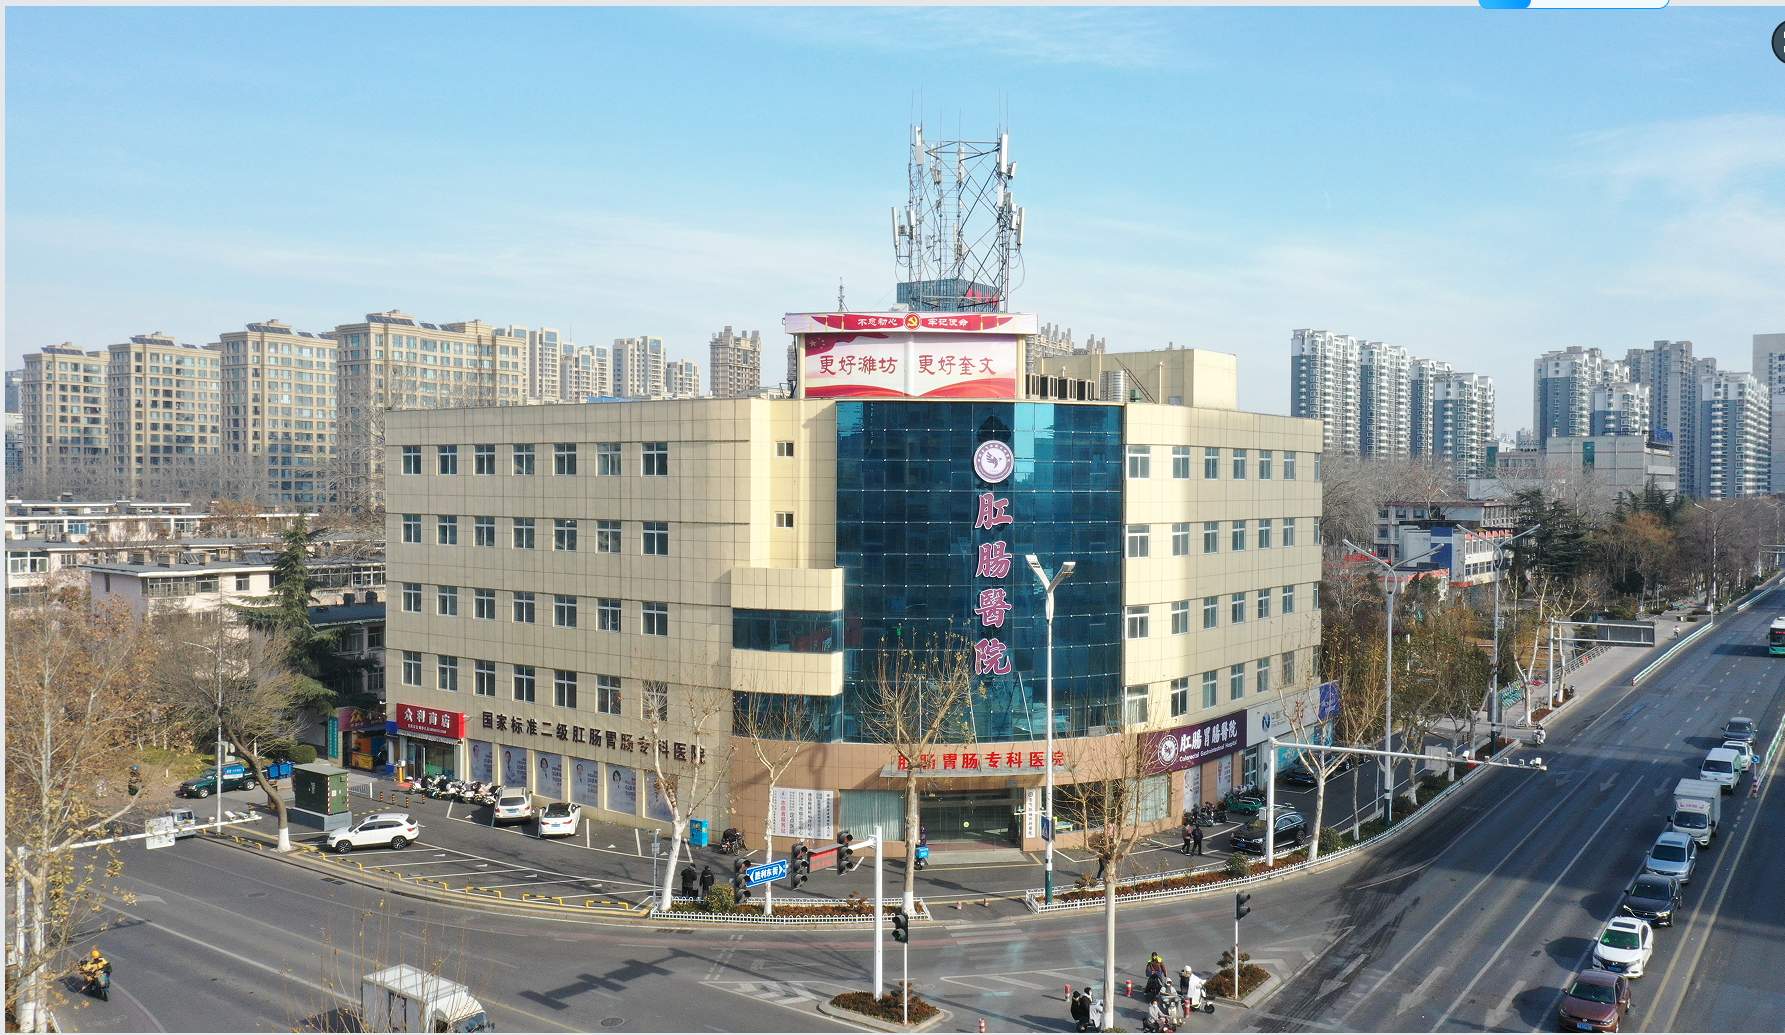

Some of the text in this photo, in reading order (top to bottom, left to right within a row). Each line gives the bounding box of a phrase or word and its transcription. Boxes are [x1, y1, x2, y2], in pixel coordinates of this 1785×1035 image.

[918, 354, 997, 376] 更好奎文
[974, 492, 1014, 676] 肛腸醫院
